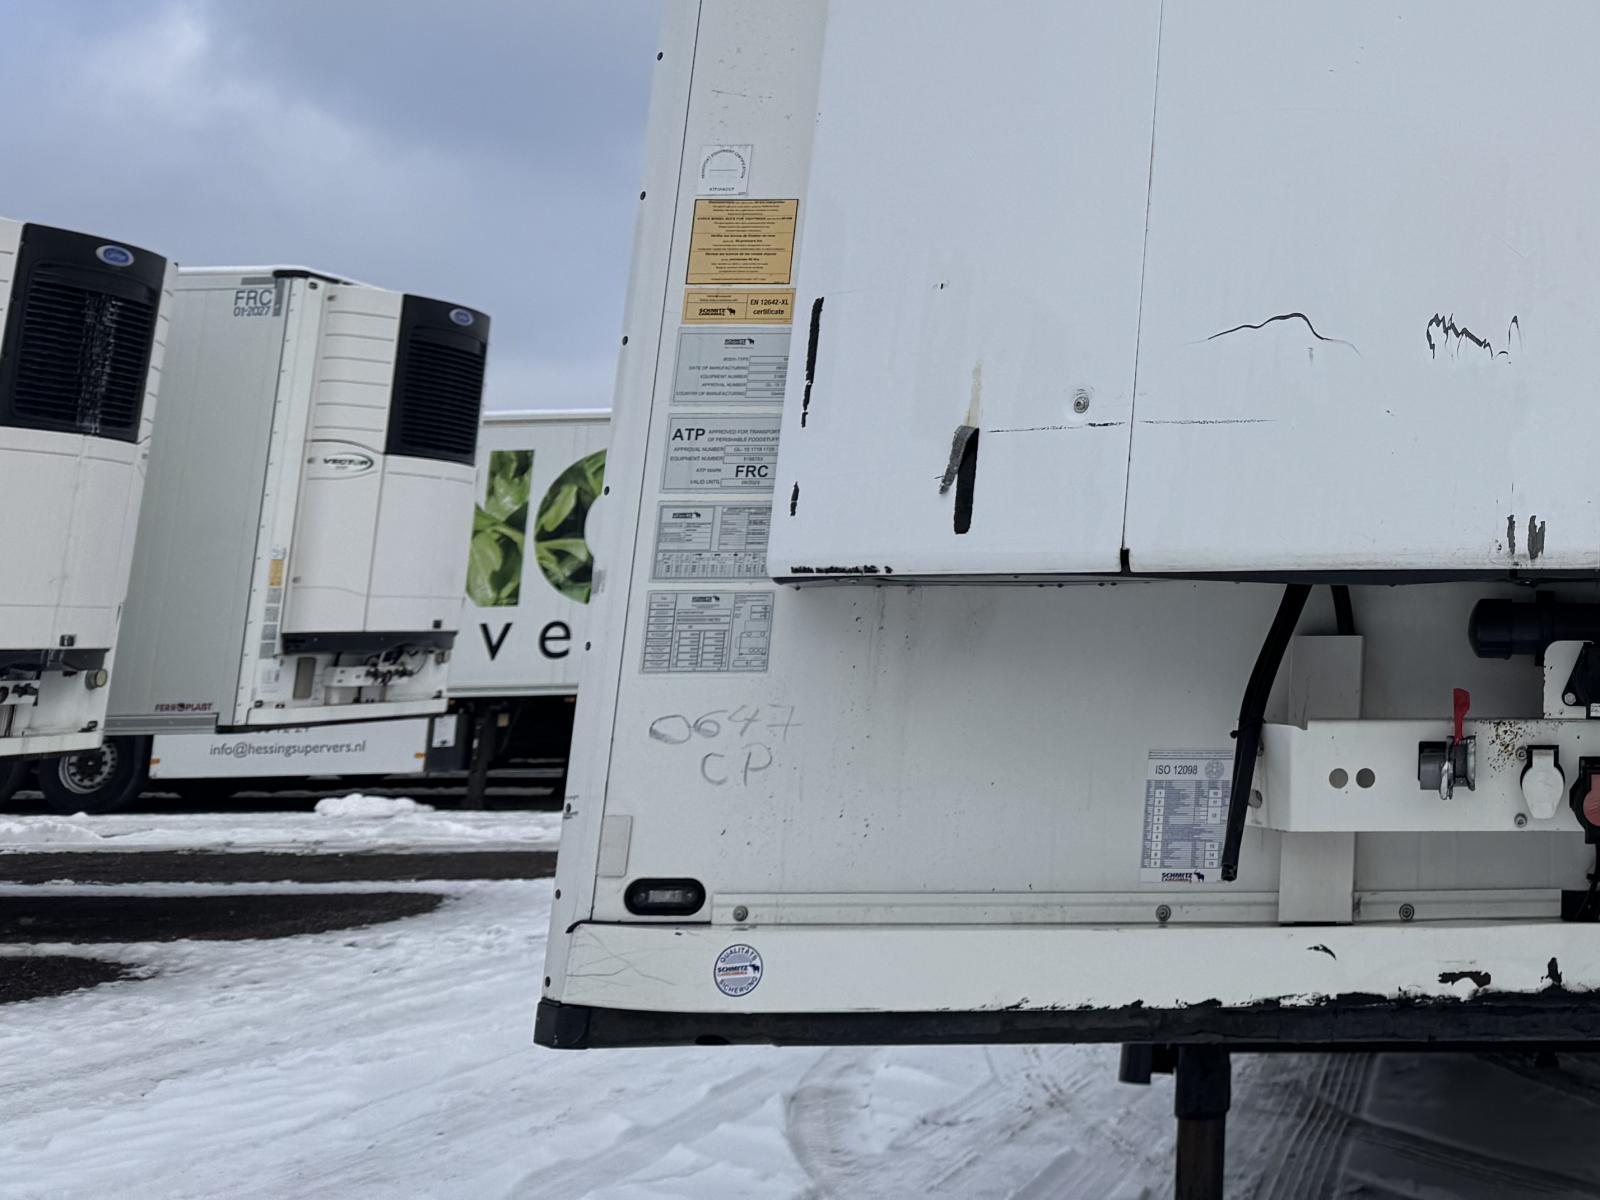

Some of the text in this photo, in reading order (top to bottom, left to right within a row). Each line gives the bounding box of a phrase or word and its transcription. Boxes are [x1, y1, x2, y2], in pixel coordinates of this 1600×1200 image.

[233, 289, 273, 306] FRC
[672, 428, 706, 441] ATP
[735, 465, 769, 478] FRC
[209, 740, 367, 758] info@hessingsupervers.nl
[1155, 765, 1198, 775] ISO 12098
